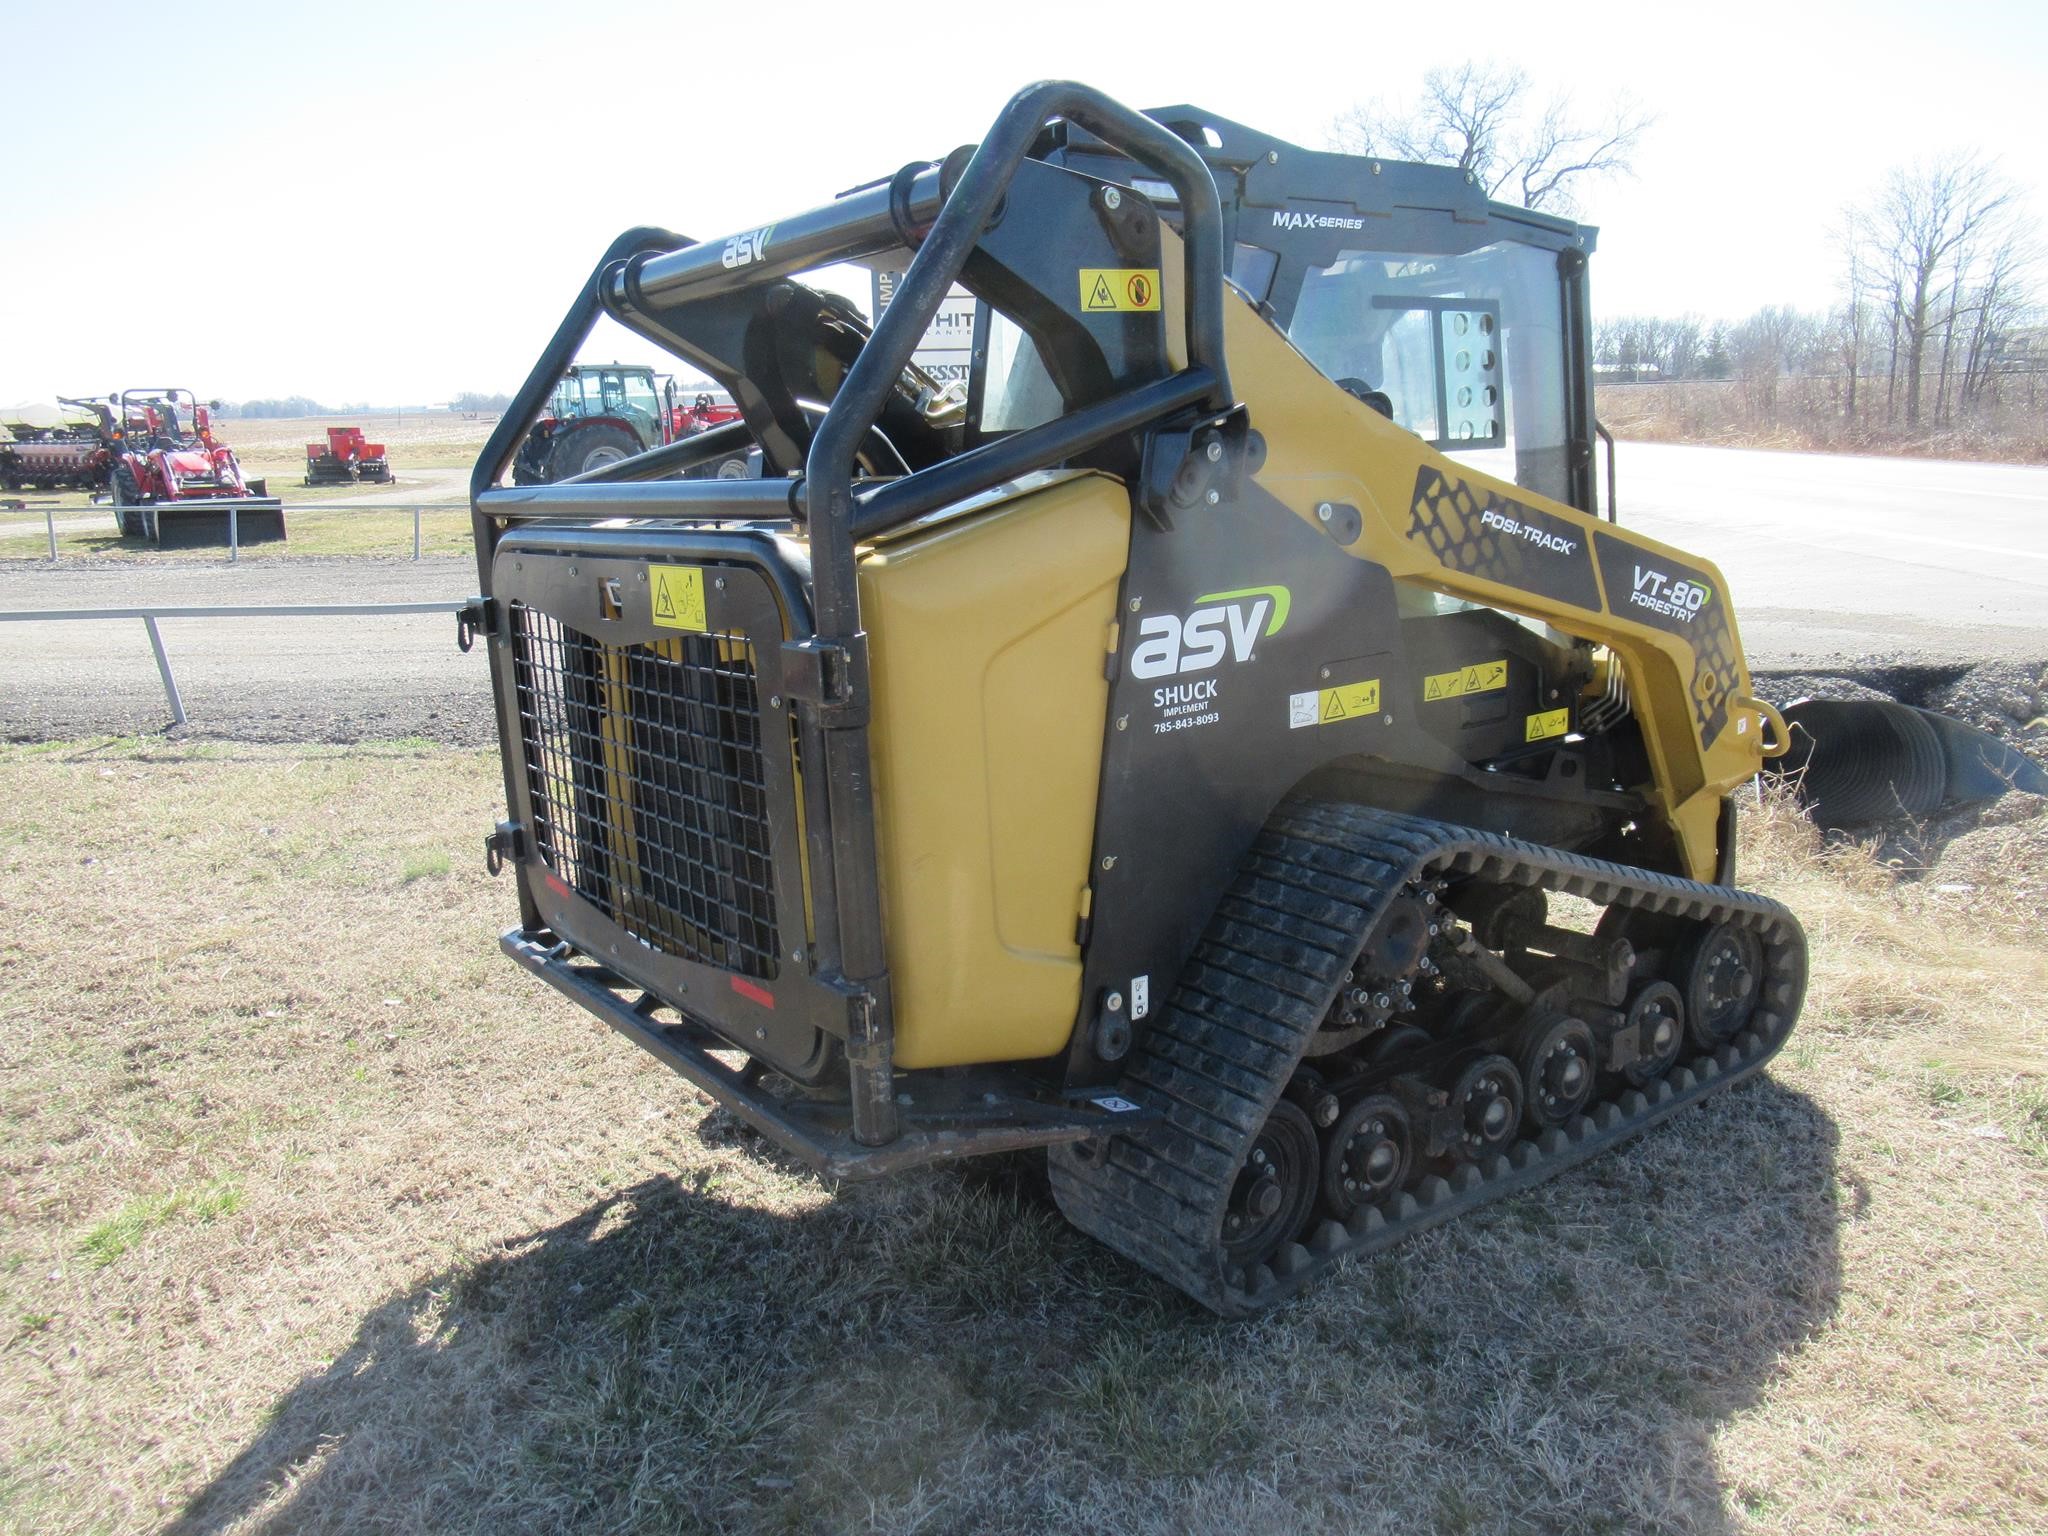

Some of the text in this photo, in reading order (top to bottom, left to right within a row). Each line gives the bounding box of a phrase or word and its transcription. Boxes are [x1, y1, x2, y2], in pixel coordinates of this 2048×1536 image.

[1272, 211, 1363, 231] MAX-SERIES
[879, 272, 893, 306] IMP
[935, 312, 975, 328] HIT
[1480, 510, 1573, 556] POSI-TRACK
[1633, 565, 1704, 611] VT-80
[1630, 590, 1696, 623] FORESTRY
[1153, 678, 1218, 708] SHUCK
[1153, 711, 1220, 735] 785-843-8093
[1163, 700, 1209, 718] IMPLEMENT
